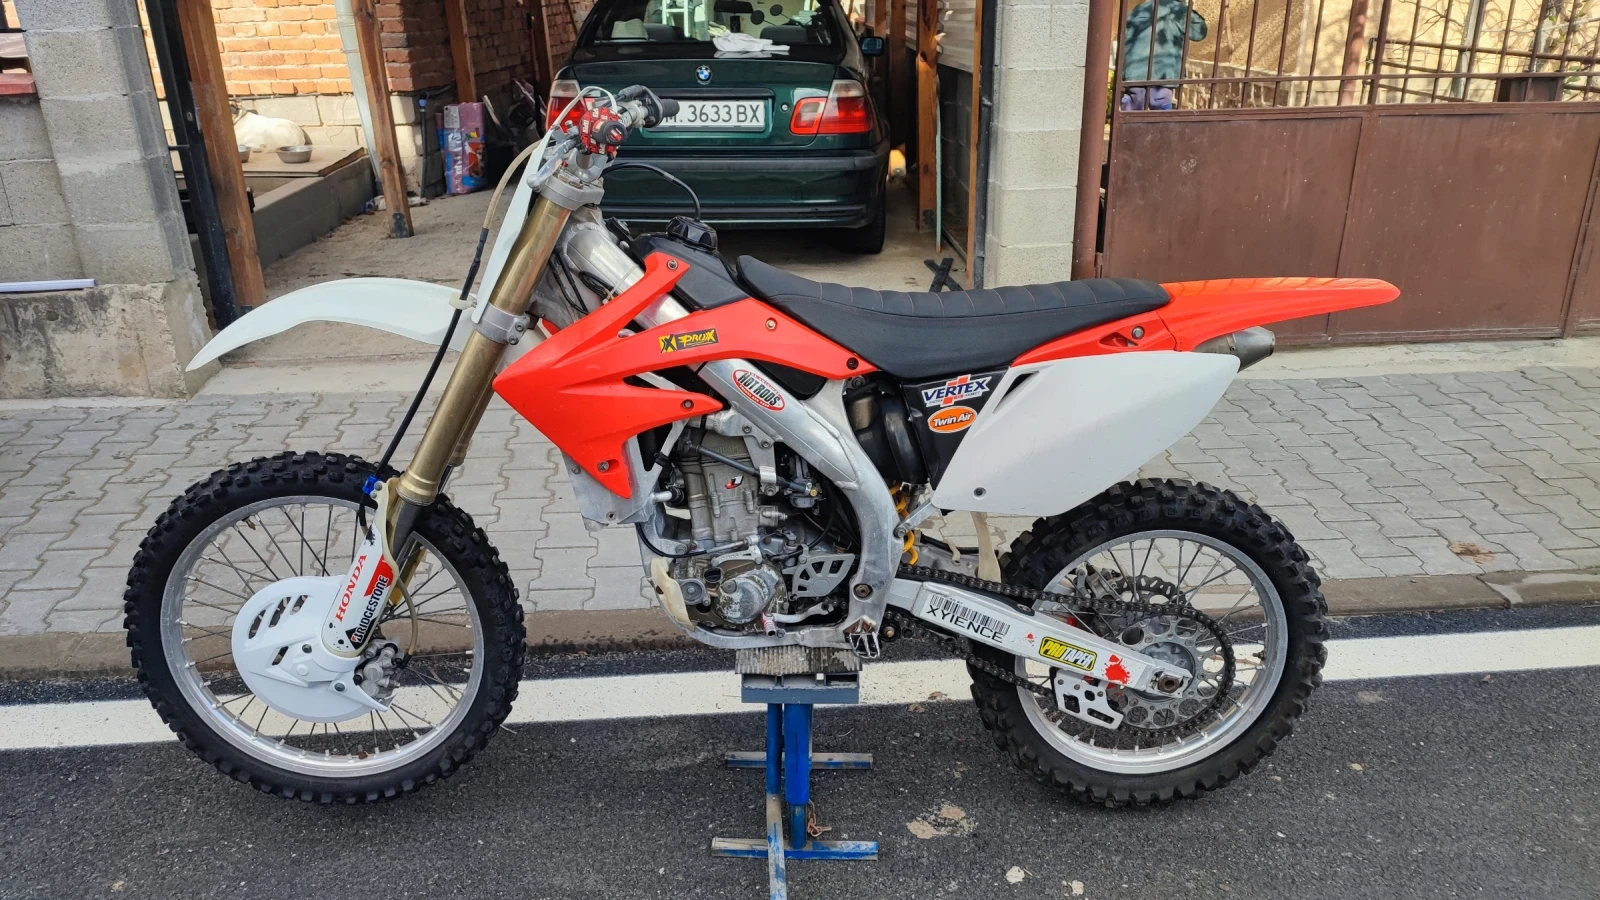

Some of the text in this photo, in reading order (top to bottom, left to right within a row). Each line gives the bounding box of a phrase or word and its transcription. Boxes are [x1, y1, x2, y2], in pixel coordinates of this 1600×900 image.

[687, 104, 733, 123] 3633
[736, 104, 761, 123] BX
[737, 372, 760, 390] HOT
[753, 384, 781, 406] RODS
[923, 379, 988, 402] VERTEX
[933, 411, 974, 428] Twin Air
[335, 554, 367, 622] HONDA
[351, 575, 389, 643] BRIDGESTONE
[926, 604, 1004, 644] XYIENCE
